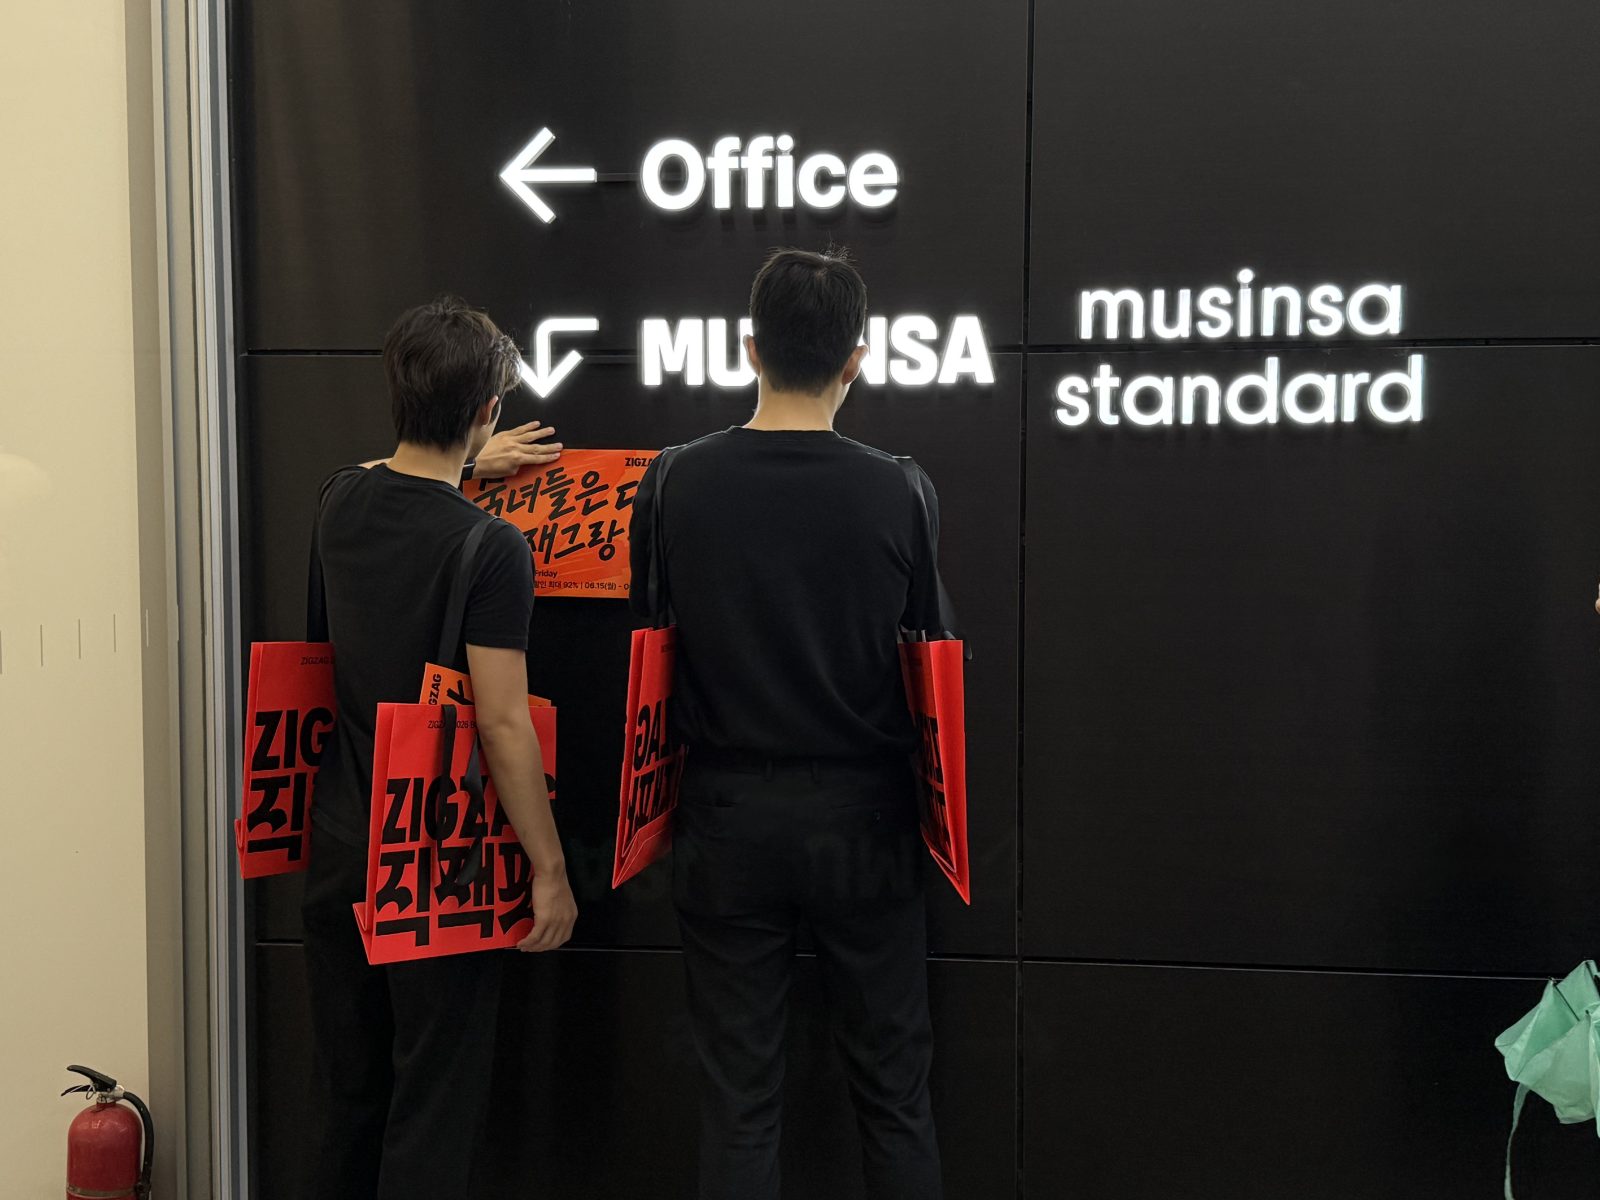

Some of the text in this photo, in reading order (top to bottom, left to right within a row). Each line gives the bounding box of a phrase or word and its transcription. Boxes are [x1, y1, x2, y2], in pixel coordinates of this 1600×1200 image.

[640, 134, 899, 211] Office
[1078, 267, 1402, 339] musinsa
[641, 314, 995, 387] MUNSA
[1054, 354, 1425, 427] standard
[625, 457, 653, 467] ZIGZ
[523, 519, 625, 564] 재그랑
[428, 673, 442, 705] GZAG
[251, 706, 336, 771] ZIG
[381, 773, 556, 845] ZIGZ
